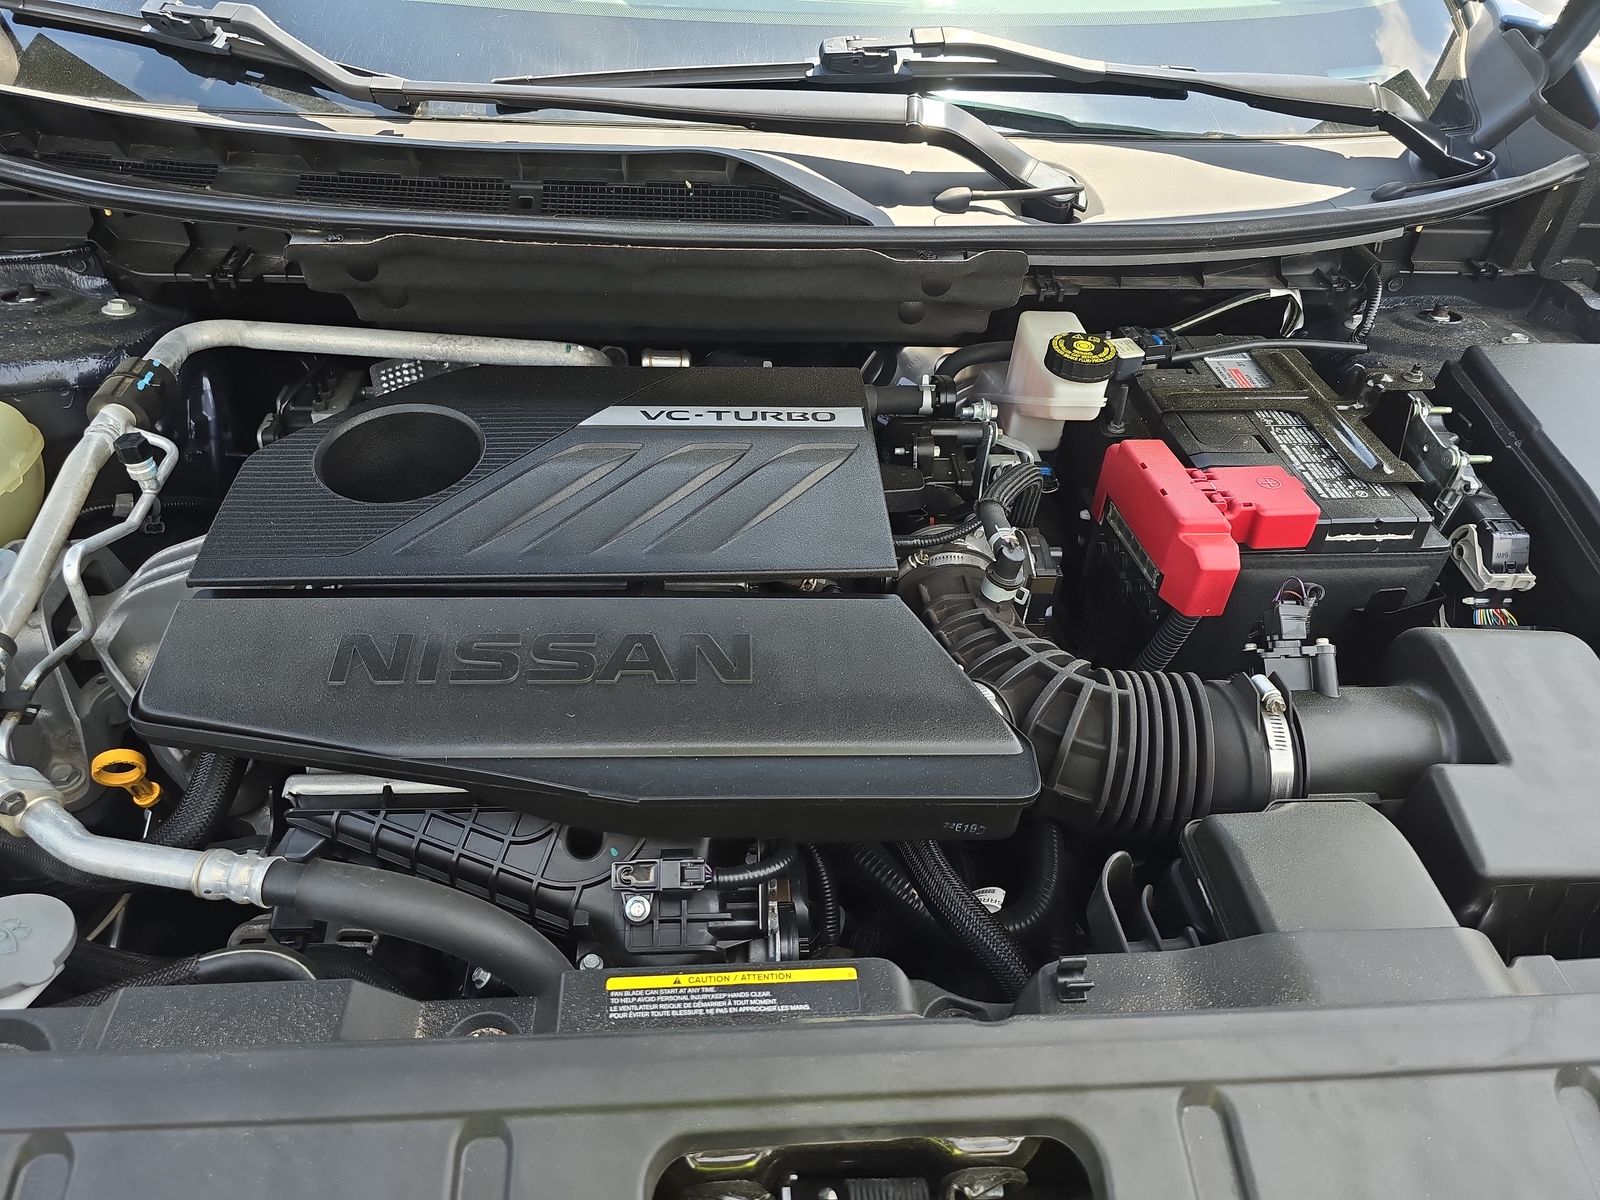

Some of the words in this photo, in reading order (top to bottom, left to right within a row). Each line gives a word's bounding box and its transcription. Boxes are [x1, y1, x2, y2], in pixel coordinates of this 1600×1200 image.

[639, 410, 836, 422] VC-TURBO
[327, 633, 753, 685] NISSAN
[688, 975, 730, 984] CAUTION
[740, 972, 792, 981] ATTENTION
[637, 995, 656, 1003] AVOID
[657, 994, 689, 1002] PERSONAL
[728, 991, 749, 999] HANDS
[619, 1003, 659, 1011] VENTILATEUR
[659, 1002, 682, 1010] RISQUE
[739, 1005, 777, 1013] APPROCHER
